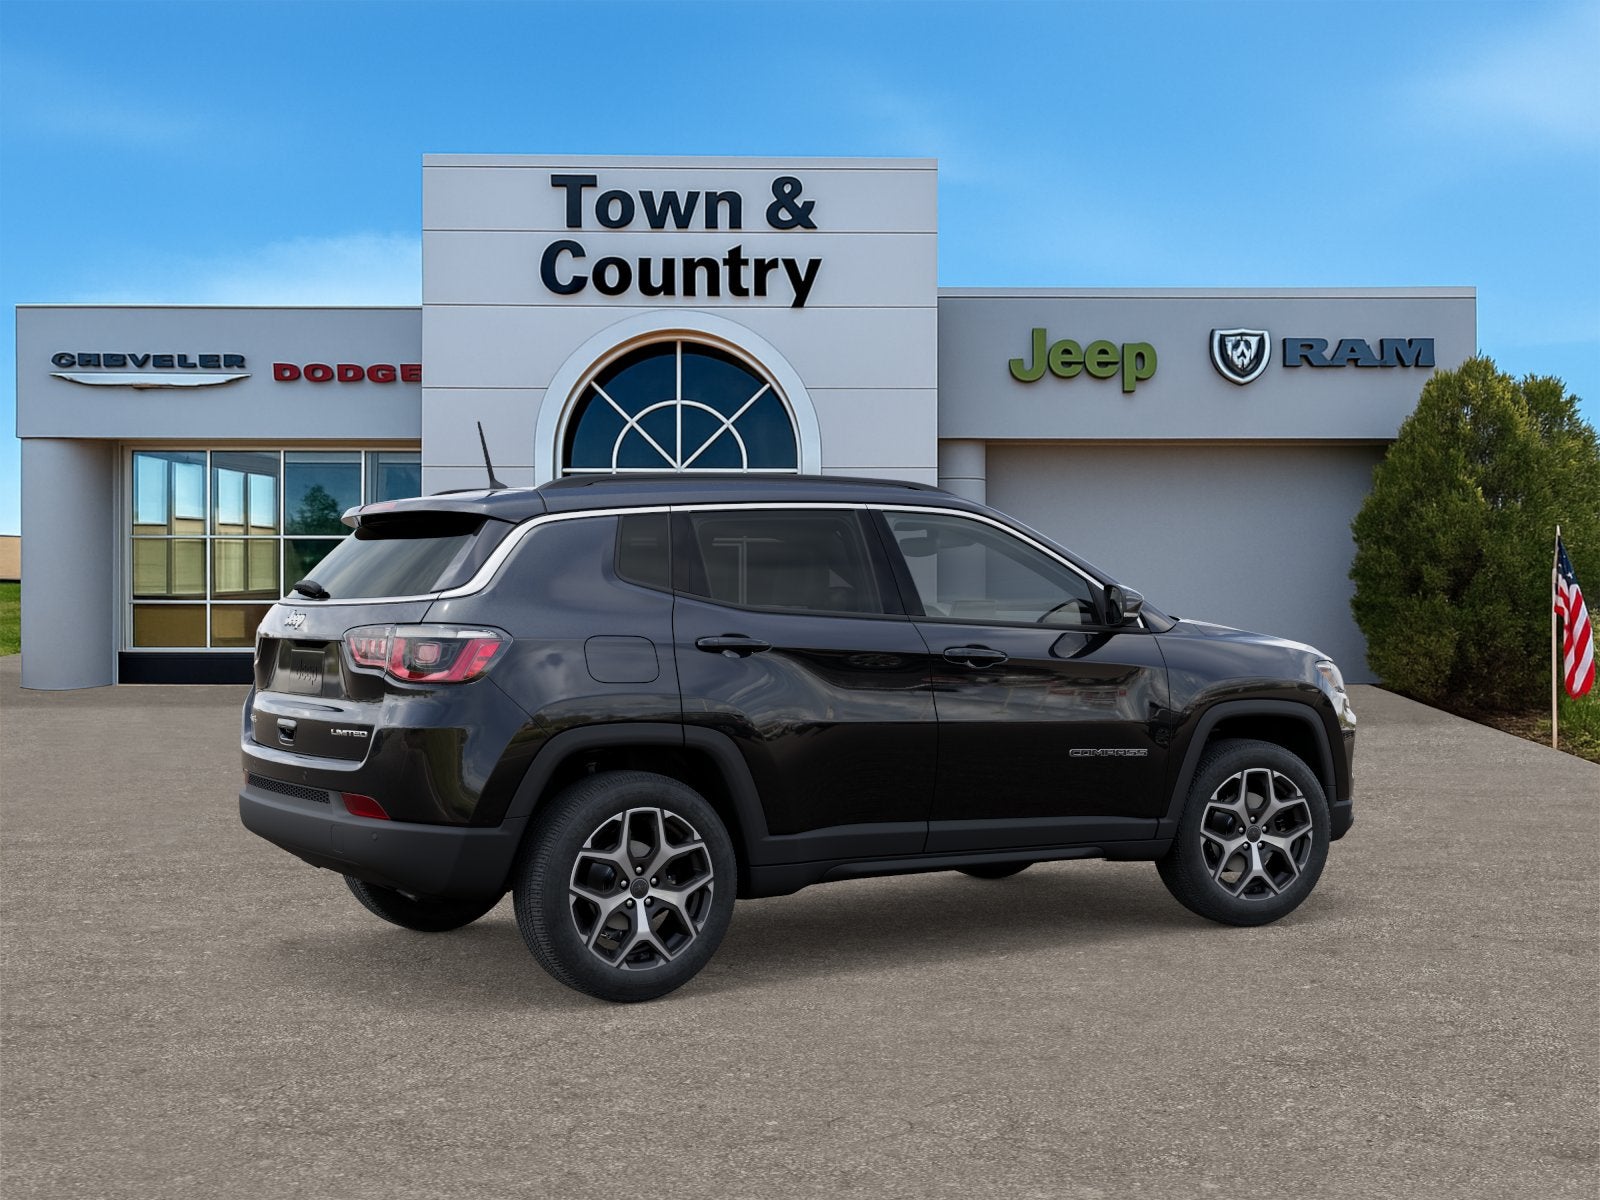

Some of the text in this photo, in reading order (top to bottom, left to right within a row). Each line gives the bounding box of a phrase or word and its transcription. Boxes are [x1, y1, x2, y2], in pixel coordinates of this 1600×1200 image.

[550, 174, 818, 229] Town &
[540, 239, 822, 308] Country
[1008, 327, 1158, 393] Jeep
[1282, 337, 1436, 368] RAM
[273, 362, 422, 383] DODGE
[330, 728, 369, 738] LIMITED
[1068, 748, 1149, 757] COMPASS
